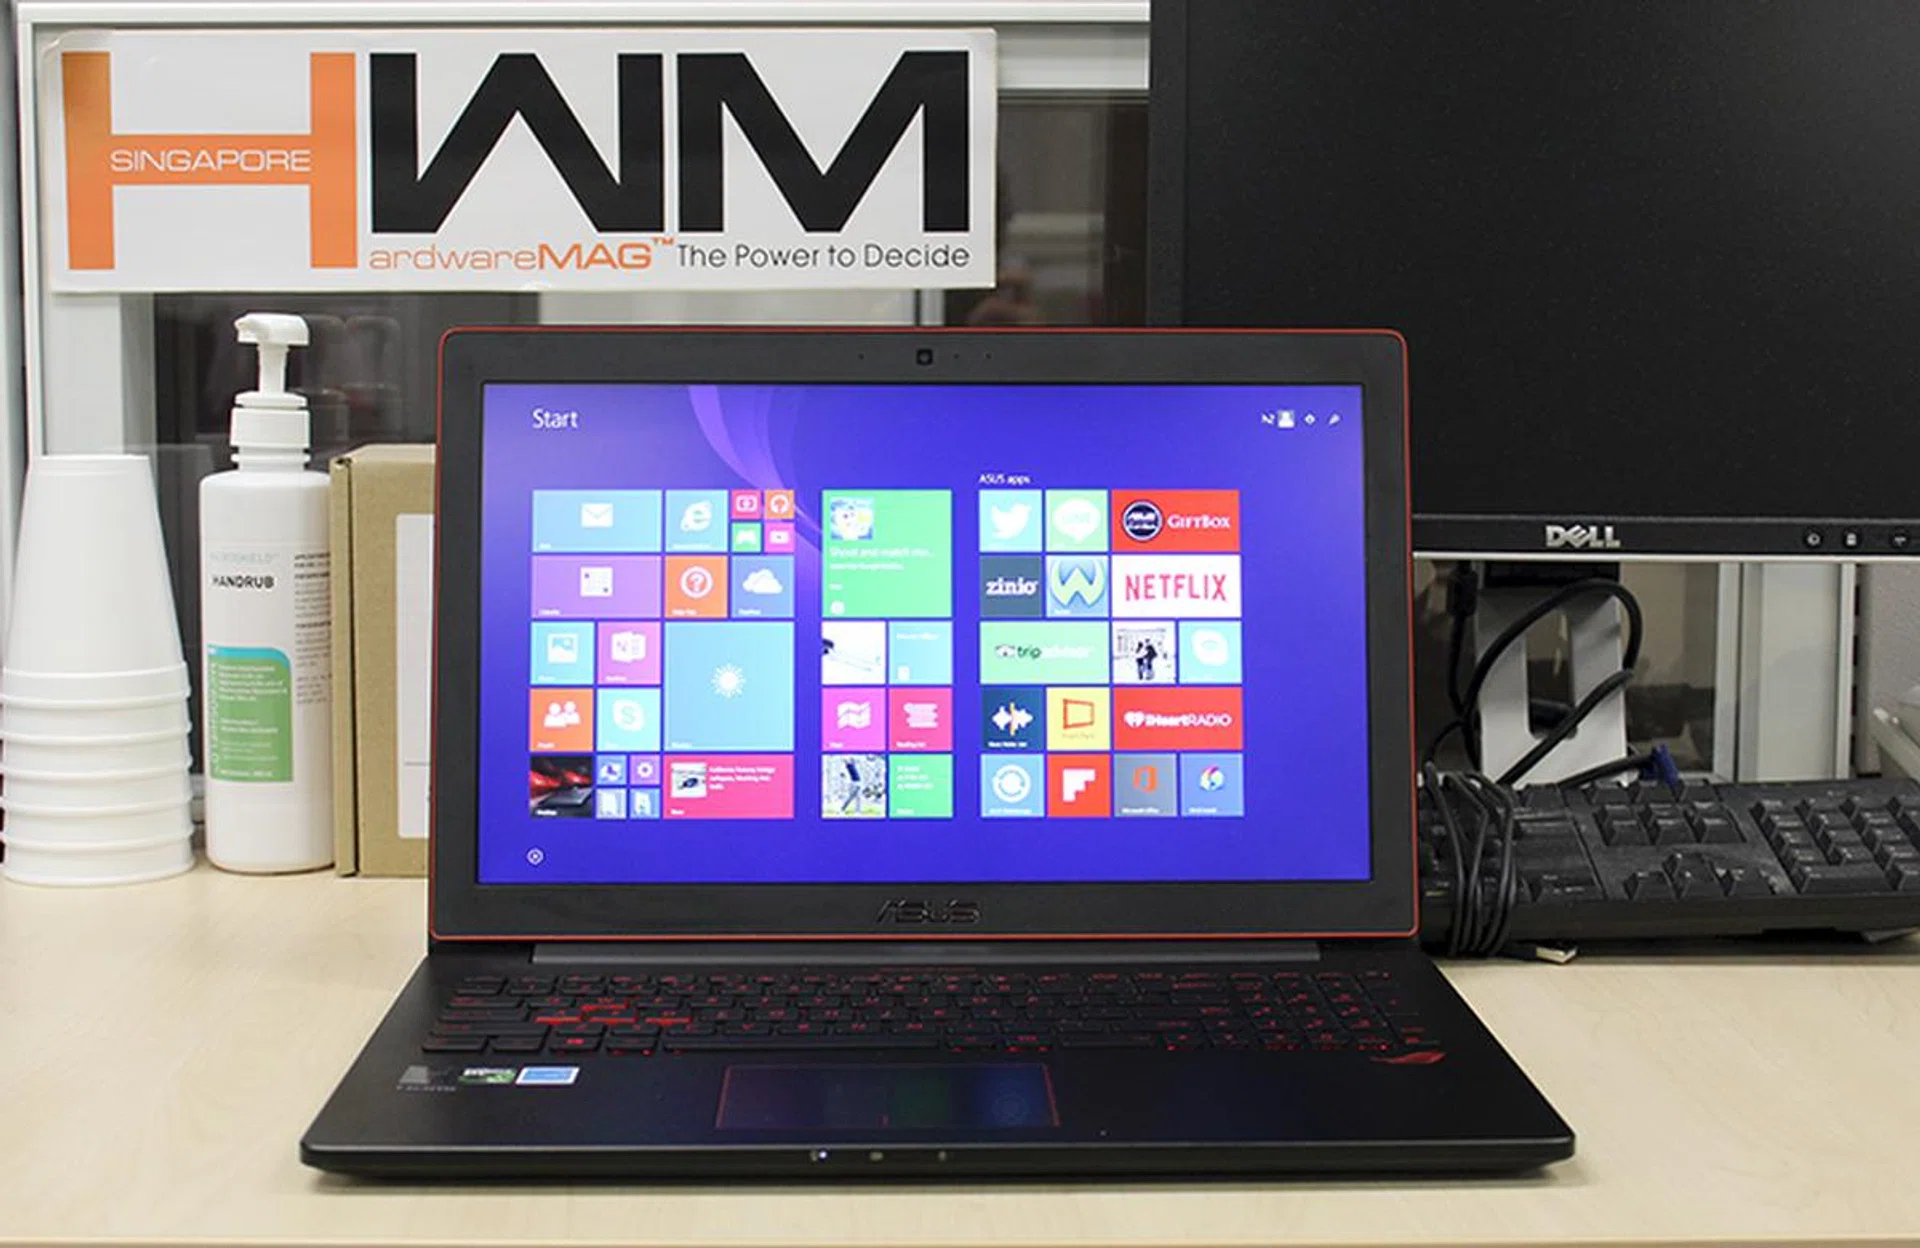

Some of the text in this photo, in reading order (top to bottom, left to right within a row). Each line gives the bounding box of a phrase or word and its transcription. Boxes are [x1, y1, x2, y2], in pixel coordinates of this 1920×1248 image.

[110, 148, 311, 173] SINGAPORE
[679, 243, 971, 268] The Power to Decide
[532, 408, 578, 429] Start
[1007, 475, 1031, 486] apps
[1545, 524, 1622, 549] DELL
[1125, 573, 1227, 602] NETFLIX
[877, 897, 982, 923] ASUS
